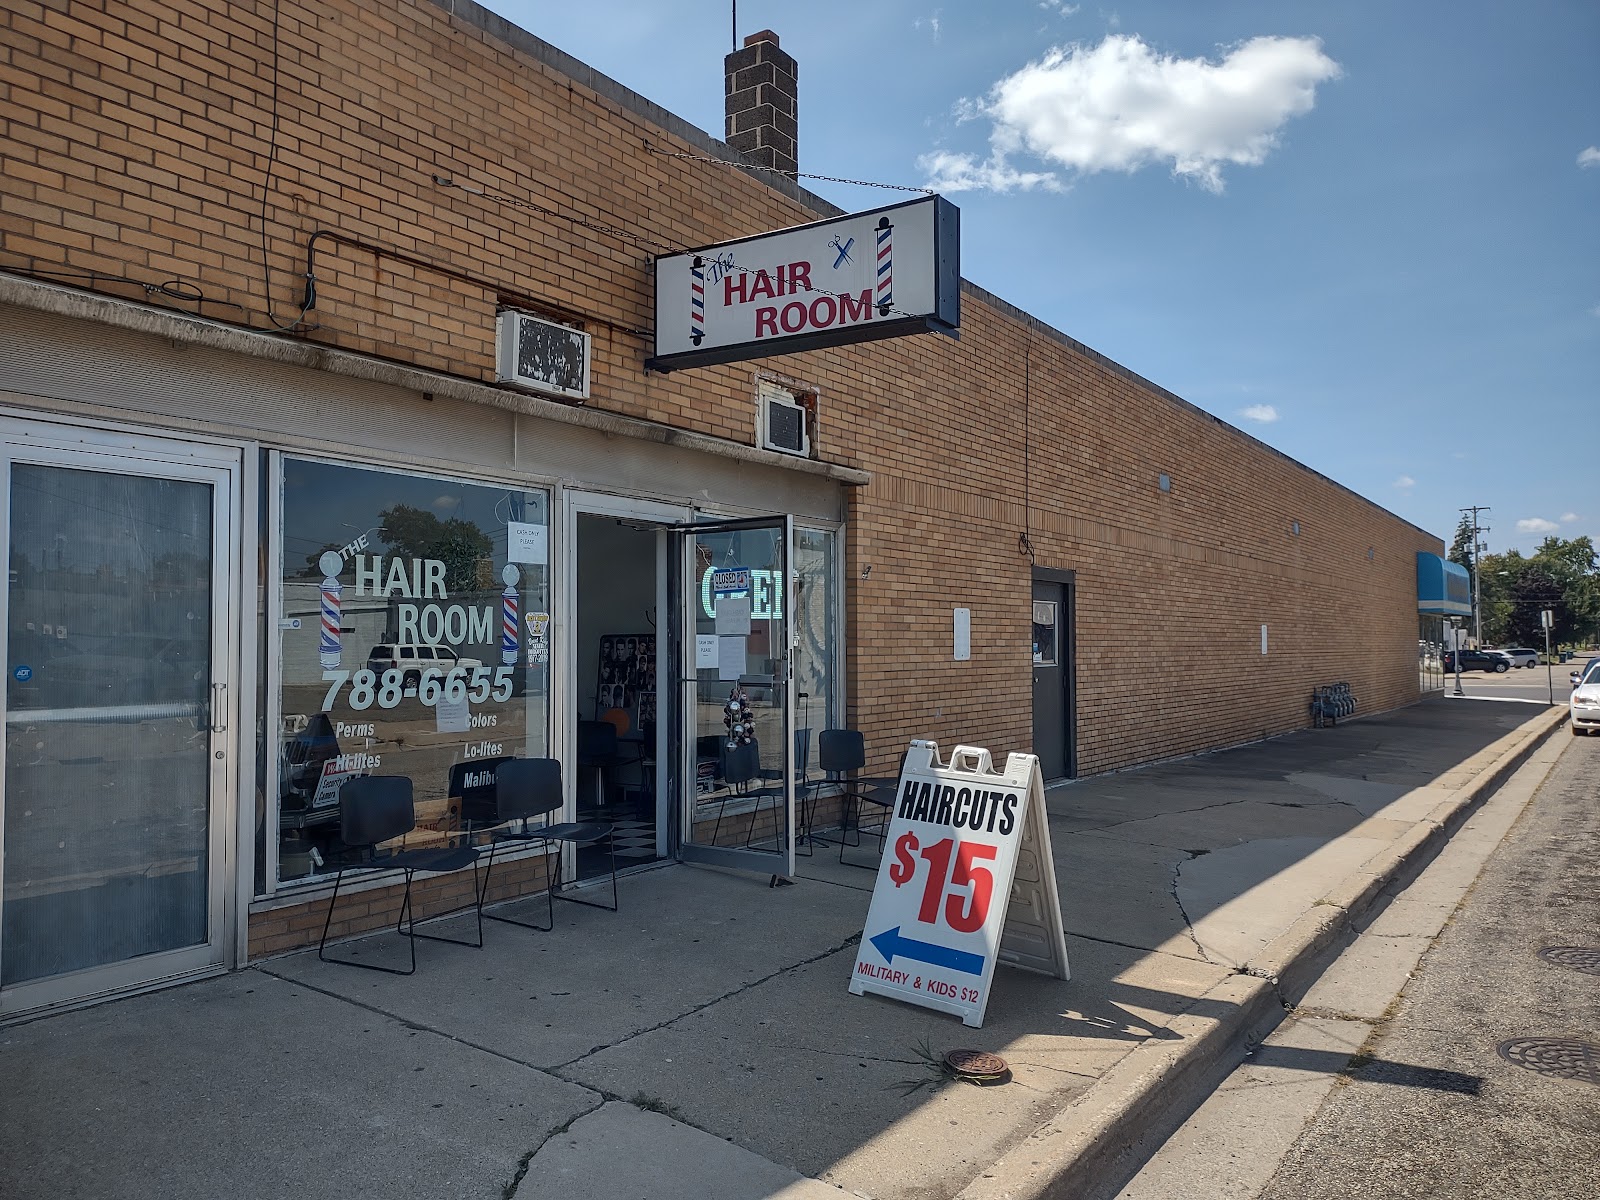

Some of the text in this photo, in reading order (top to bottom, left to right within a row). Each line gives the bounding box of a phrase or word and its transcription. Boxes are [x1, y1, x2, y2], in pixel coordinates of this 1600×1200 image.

[706, 252, 735, 285] The
[723, 261, 813, 306] HAIR
[754, 288, 873, 338] ROOM
[338, 534, 370, 562] THE
[354, 554, 448, 600] HAIR
[715, 572, 736, 585] CLOSED
[398, 603, 494, 646] ROOM
[321, 666, 515, 712] 788-6655
[336, 721, 375, 739] Perms
[465, 712, 498, 729] Colors
[463, 741, 503, 759] Lo-lites
[897, 780, 1018, 836] HAIRCUTS
[889, 831, 998, 934] $15
[857, 961, 979, 1004] MILITARY & KIDS $12
